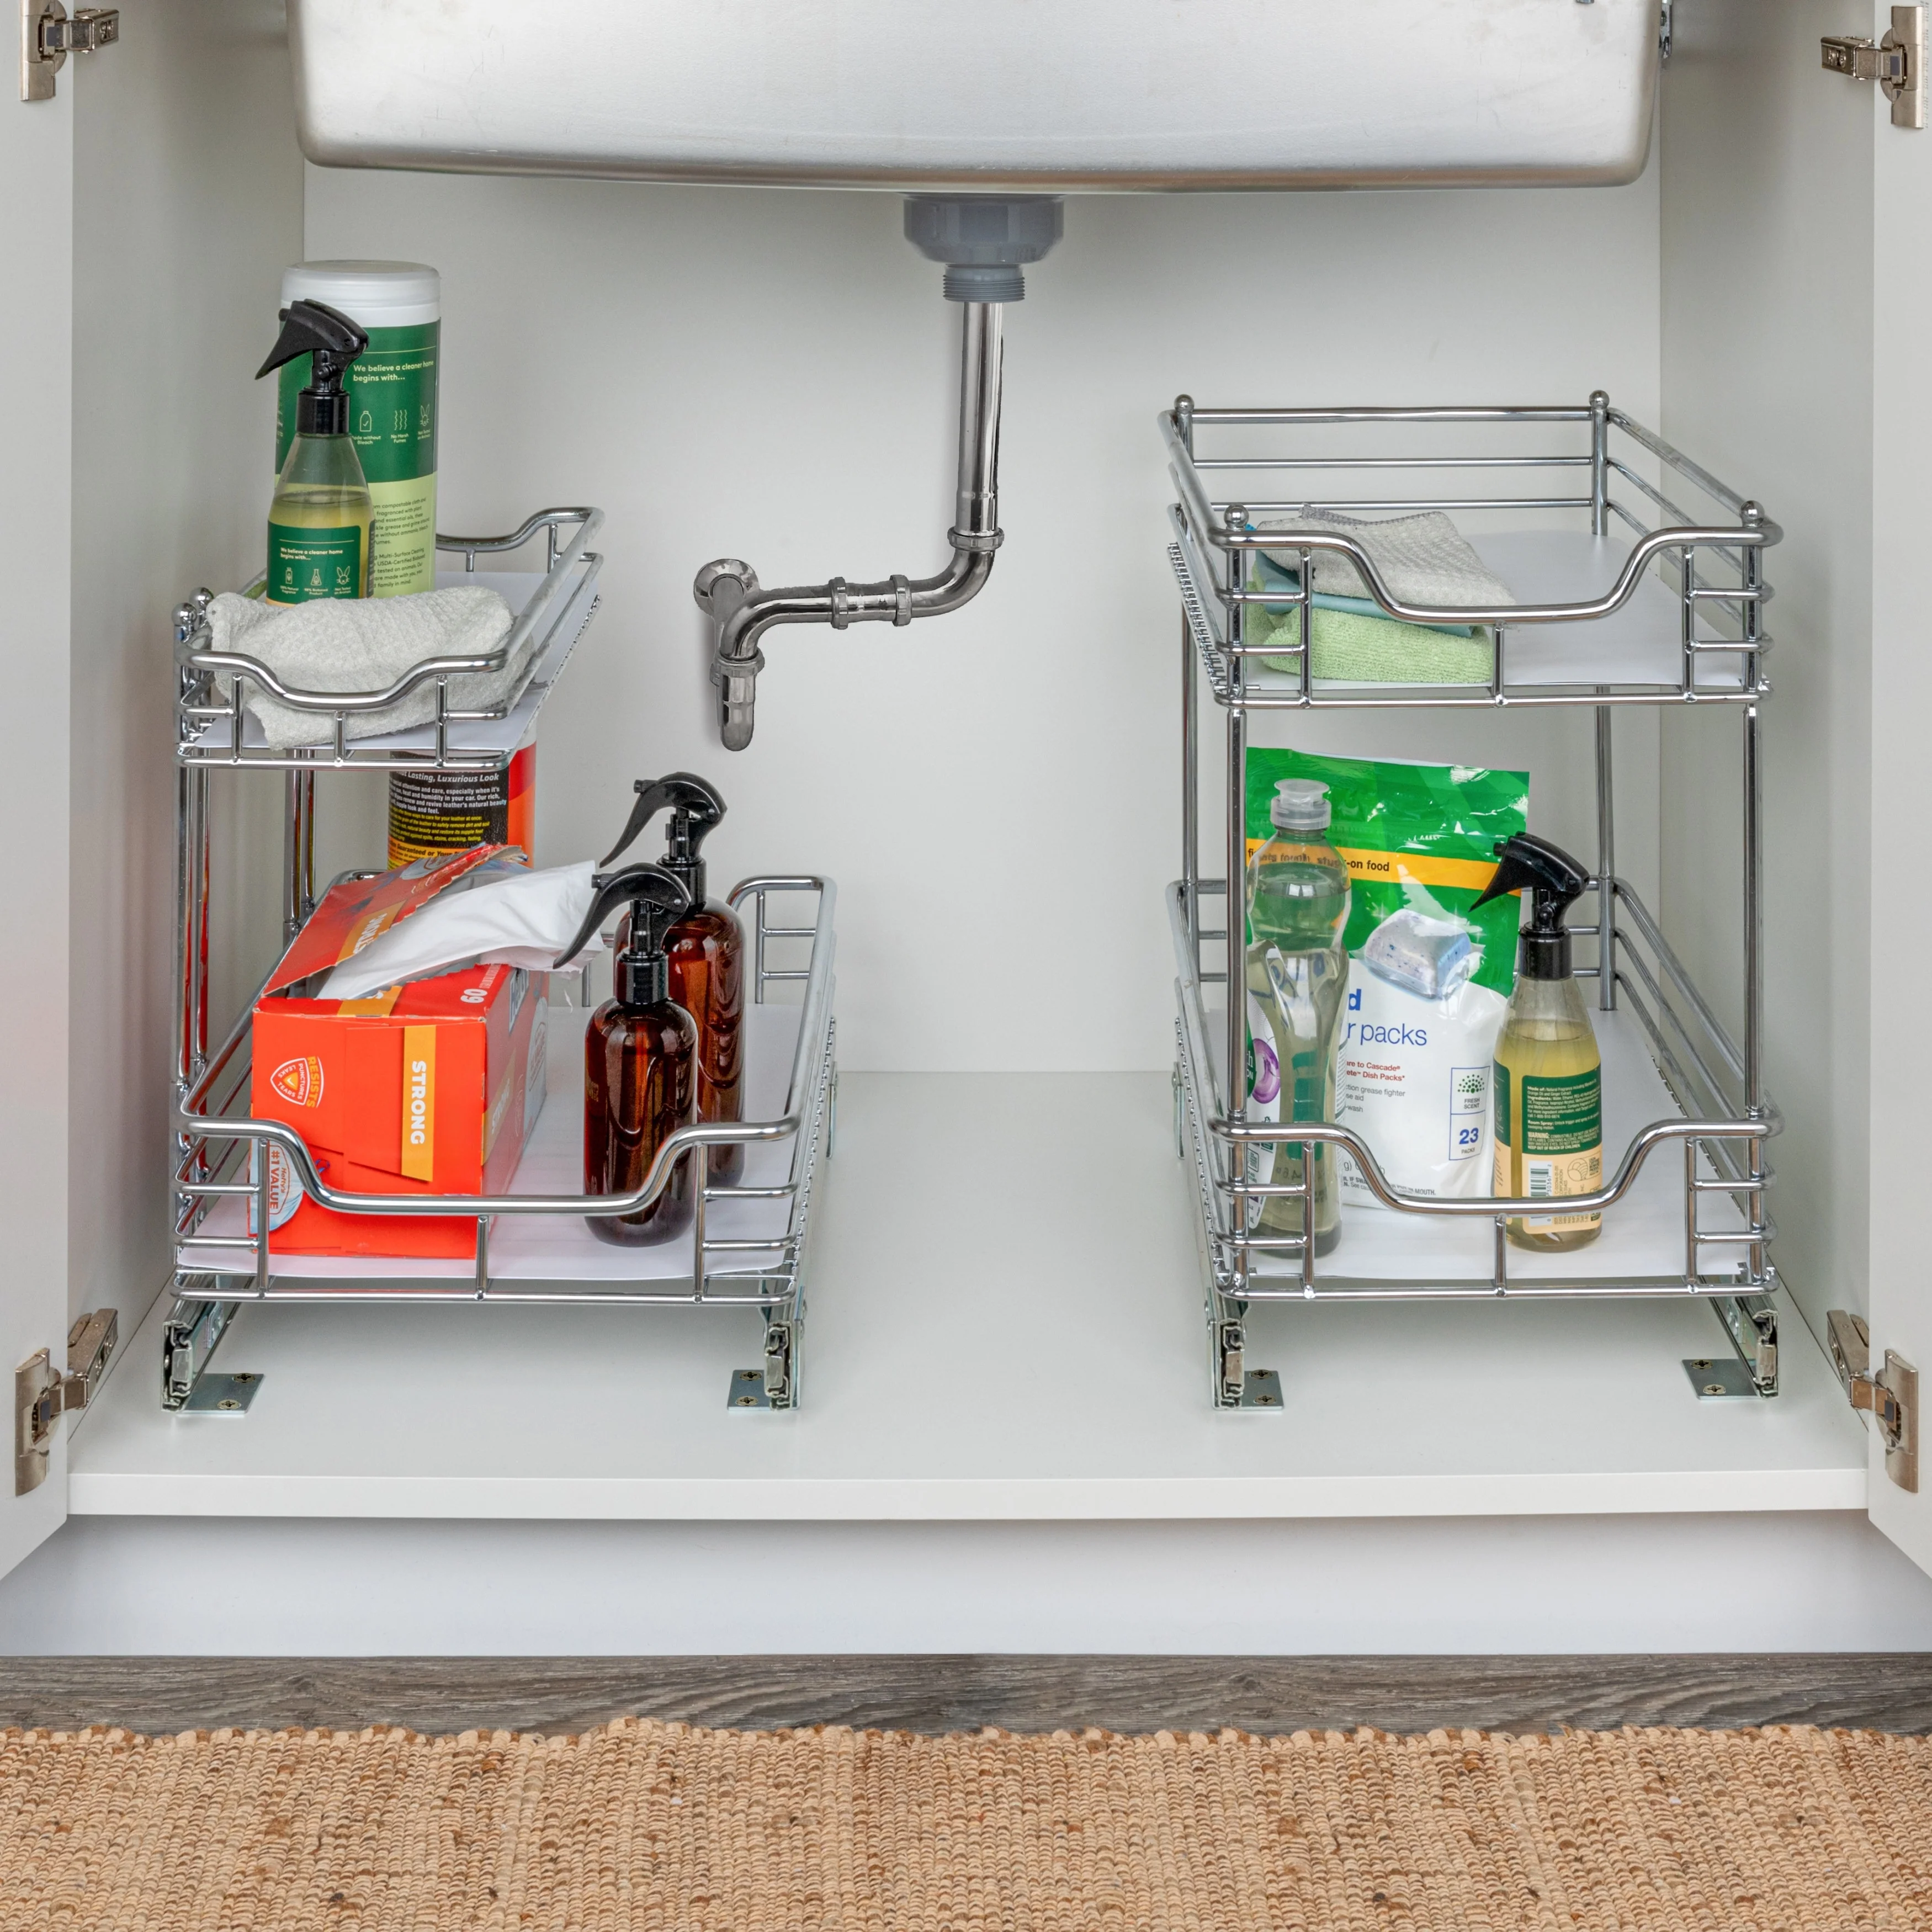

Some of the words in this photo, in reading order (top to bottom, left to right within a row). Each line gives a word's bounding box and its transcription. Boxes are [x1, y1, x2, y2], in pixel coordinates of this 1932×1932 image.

[402, 362, 422, 370] cleaner
[353, 374, 379, 383] begins
[377, 558, 412, 566] USDA-Certified
[408, 771, 436, 783] Lasting,
[437, 774, 477, 783] Luxurious
[479, 773, 499, 782] Look
[446, 787, 474, 795] especially
[397, 843, 426, 856] Guaranteed
[1366, 859, 1390, 872] food
[460, 988, 488, 1004] 60
[1360, 1023, 1427, 1047] packs
[278, 1065, 296, 1079] LEAKS
[1362, 1071, 1378, 1079] Dish
[297, 1063, 305, 1100] PUNCTURES
[306, 1056, 320, 1108] RESISTS
[278, 1081, 296, 1097] TEARS
[1384, 1089, 1405, 1097] fighter
[410, 1060, 427, 1144] STRONG
[1459, 1127, 1479, 1144] 23
[271, 1150, 280, 1165] #1
[269, 1167, 280, 1209] VALUE
